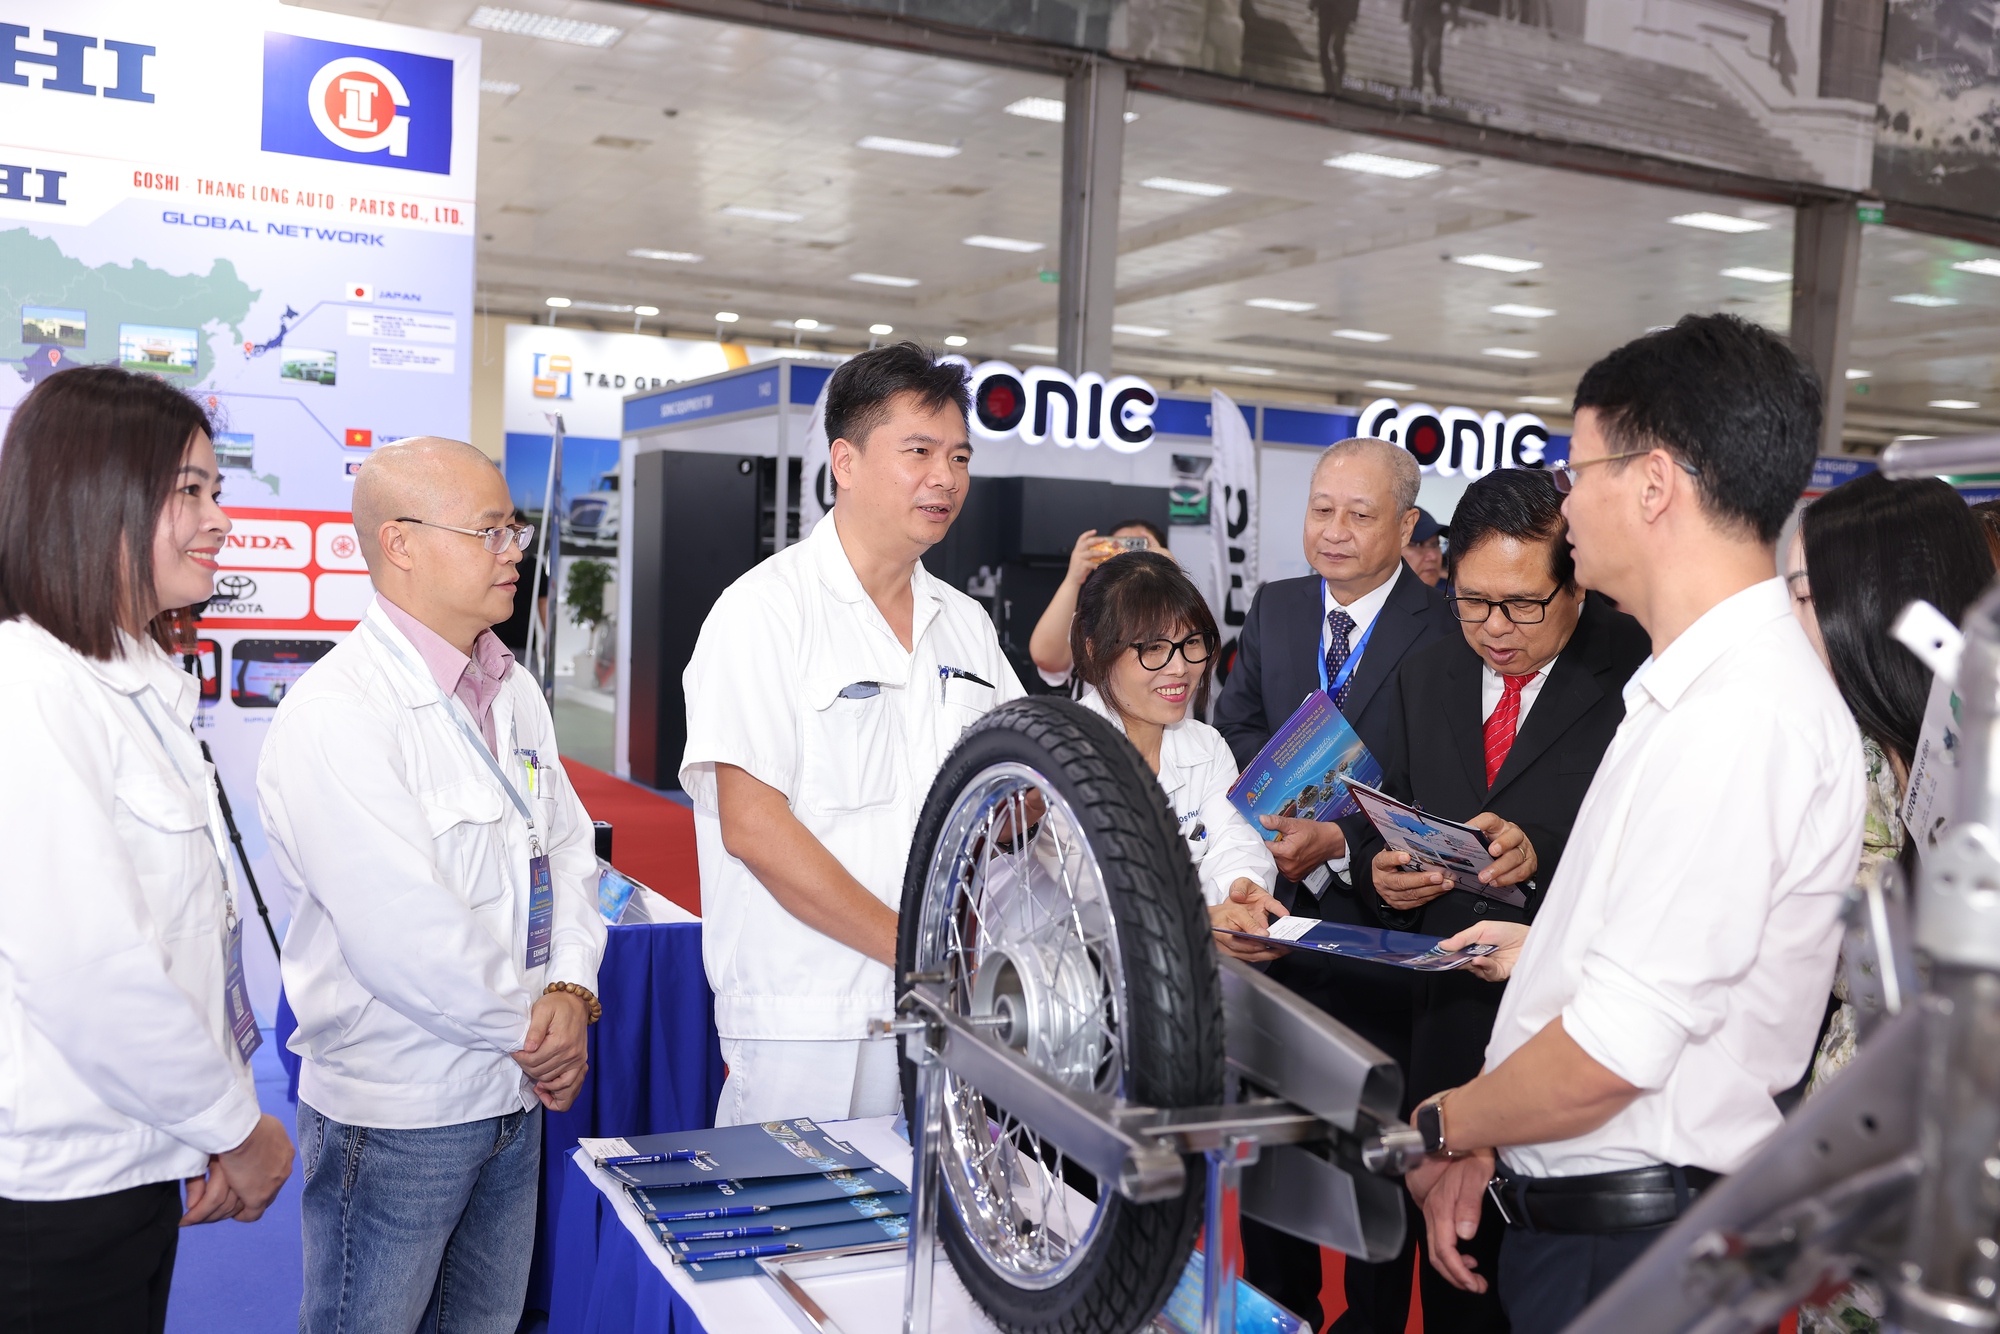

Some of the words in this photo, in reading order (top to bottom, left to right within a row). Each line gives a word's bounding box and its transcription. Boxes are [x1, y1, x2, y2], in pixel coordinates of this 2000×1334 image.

[133, 170, 179, 192] GOSHI
[197, 178, 245, 199] THANG
[252, 185, 289, 205] LONG
[296, 191, 334, 210] AUTO
[350, 197, 395, 217] PARTS
[401, 203, 428, 223] CO.,
[435, 207, 464, 226] LTD.
[162, 211, 259, 233] GLOBAL
[267, 223, 385, 247] NETWORK
[379, 290, 422, 302] JAPAN
[584, 372, 626, 389] T&D
[976, 374, 1155, 443] ONIC
[226, 535, 295, 550] NDA
[208, 602, 264, 614] TOYOTA
[1247, 771, 1271, 804] AUTO
